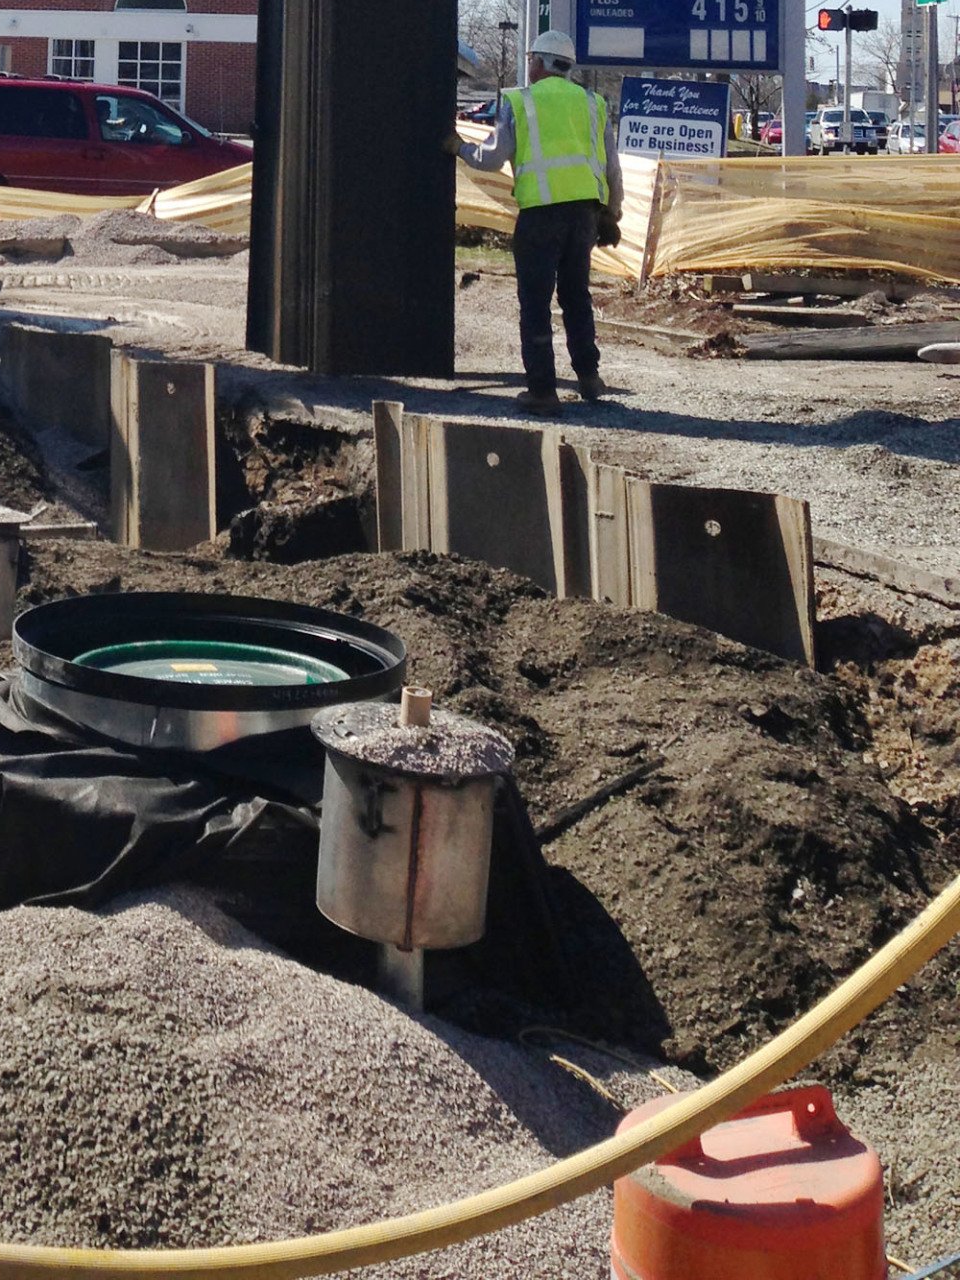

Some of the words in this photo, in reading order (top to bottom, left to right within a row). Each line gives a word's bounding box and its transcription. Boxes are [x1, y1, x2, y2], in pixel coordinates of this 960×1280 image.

[590, 8, 634, 18] UNLEADED
[642, 83, 676, 97] Thank
[678, 86, 700, 101] You
[622, 99, 639, 113] for
[641, 99, 669, 114] Your
[672, 101, 720, 116] Patience
[629, 121, 648, 134] We
[653, 126, 675, 136] are
[679, 124, 713, 140] Open
[625, 135, 644, 148] for
[648, 137, 715, 154] Business!
